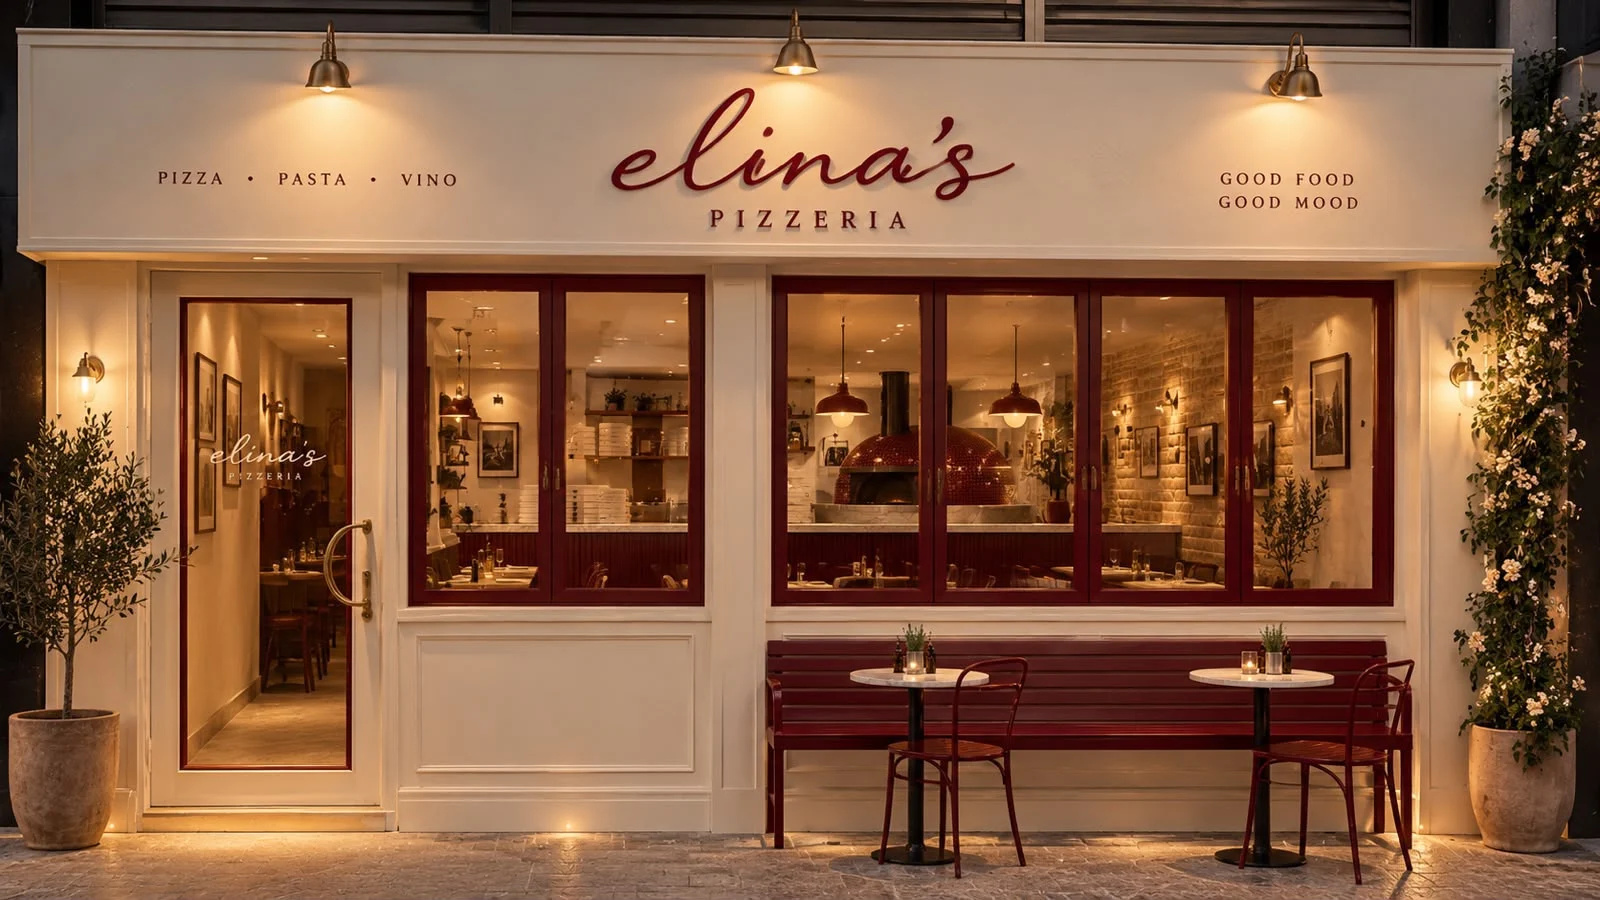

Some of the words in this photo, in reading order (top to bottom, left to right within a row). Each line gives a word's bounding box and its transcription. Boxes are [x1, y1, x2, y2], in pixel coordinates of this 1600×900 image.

[610, 87, 1016, 201] elina's
[158, 171, 223, 186] PIZZA
[278, 172, 347, 187] PASTA
[400, 173, 457, 187] VINO
[1220, 171, 1282, 186] GOOD
[1296, 172, 1354, 187] FOOD
[1218, 195, 1281, 209] GOOD
[1295, 196, 1359, 210] MOOD
[710, 209, 907, 230] PIZZERIA
[210, 433, 327, 467] elina's
[228, 472, 303, 481] PIZZERIA
